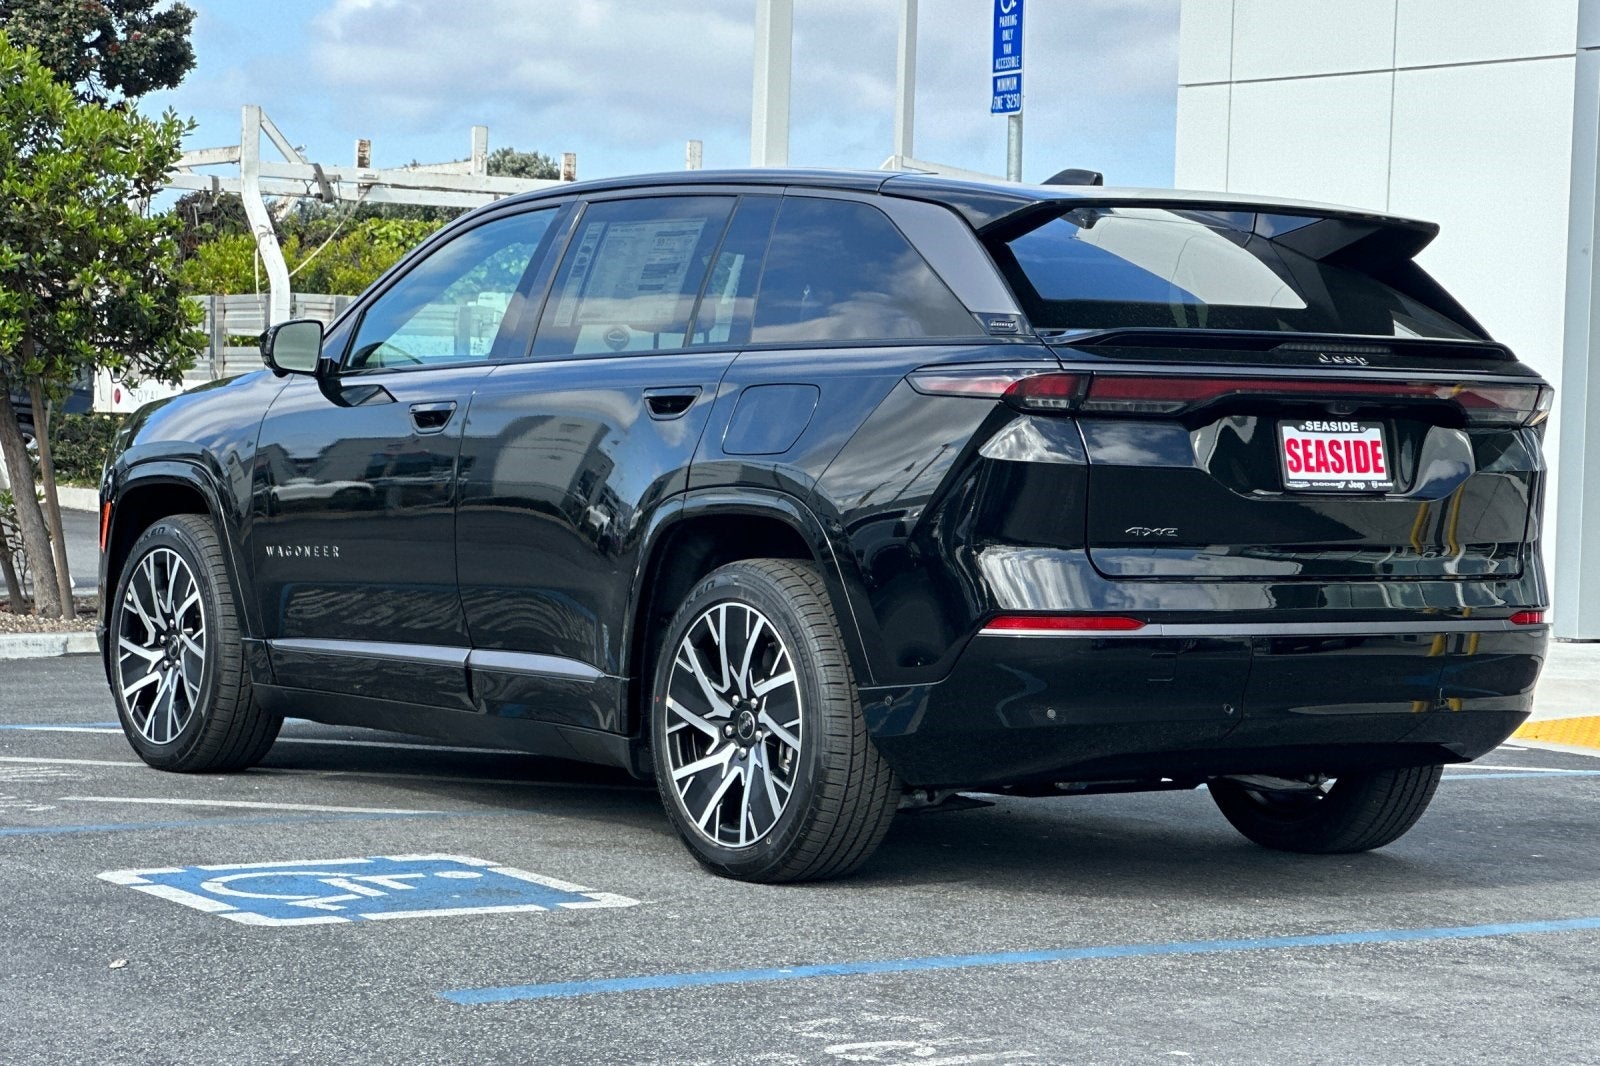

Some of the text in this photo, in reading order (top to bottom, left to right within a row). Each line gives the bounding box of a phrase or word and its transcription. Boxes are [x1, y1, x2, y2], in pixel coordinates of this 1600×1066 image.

[999, 14, 1018, 28] PARKING
[1002, 29, 1014, 41] ONLY
[1003, 43, 1012, 55] VAN
[995, 56, 1020, 70] ACCESSIBLE
[996, 77, 1017, 92] MINIMUM
[1305, 421, 1359, 432] SEASIDE
[1285, 438, 1385, 474] SEASIDE
[1348, 480, 1366, 490] Jeep
[265, 545, 340, 557] WAGONEER
